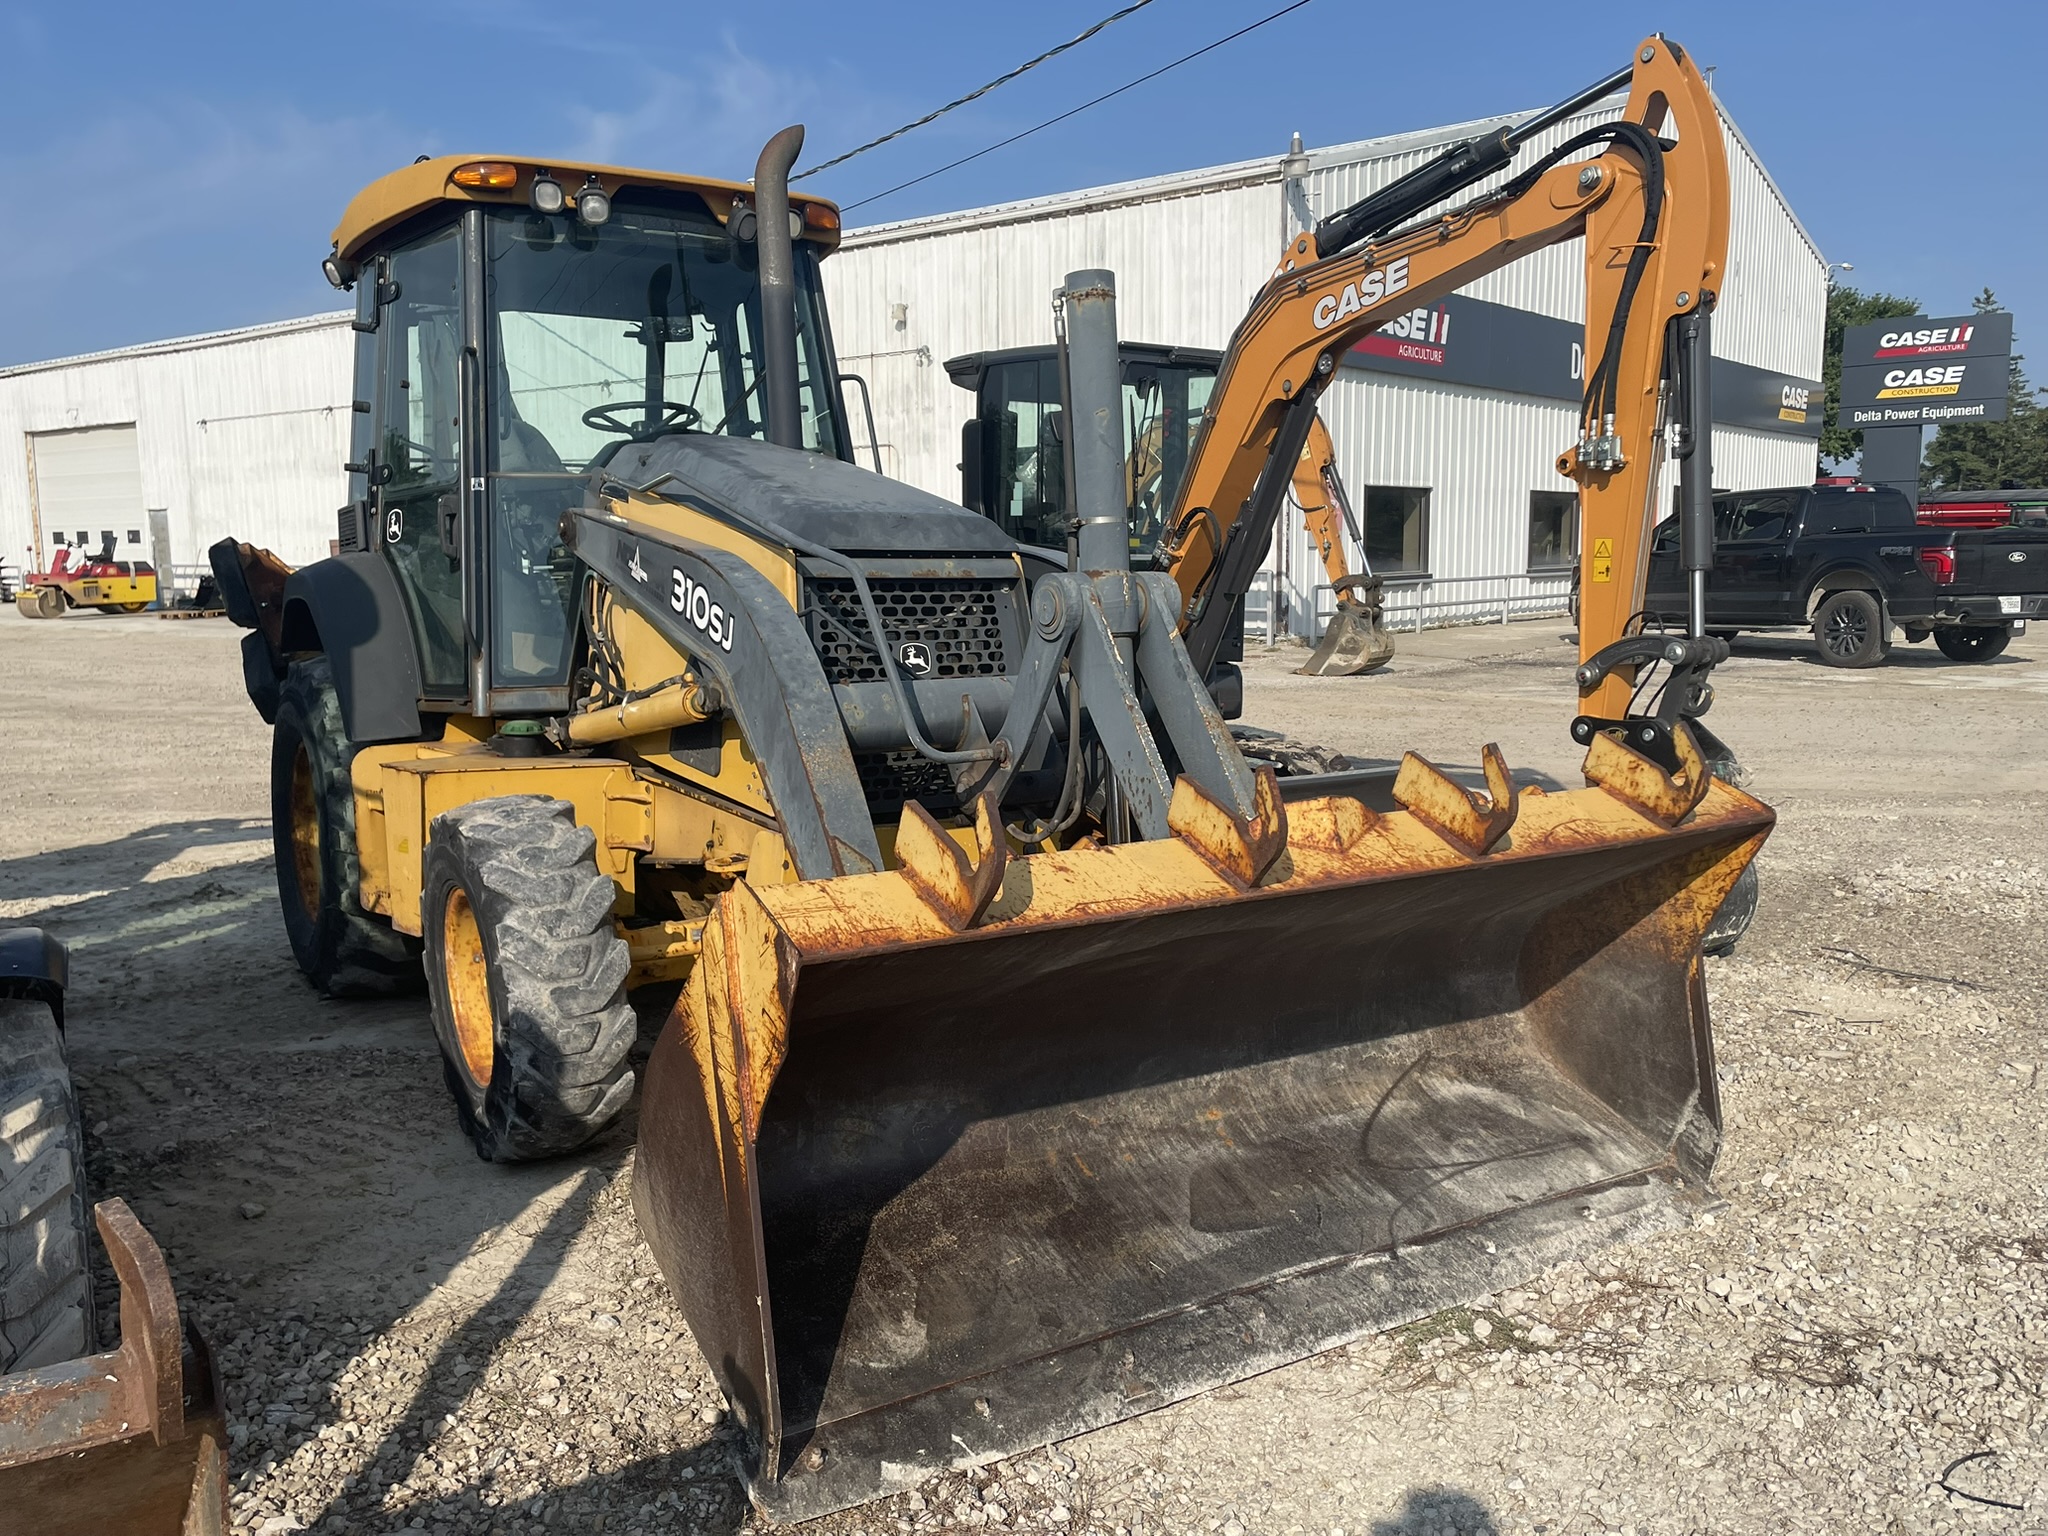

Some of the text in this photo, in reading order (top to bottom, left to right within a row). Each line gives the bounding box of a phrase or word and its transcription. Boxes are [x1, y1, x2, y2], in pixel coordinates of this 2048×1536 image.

[1313, 255, 1410, 330] CASE
[1880, 328, 1949, 348] CASE
[1918, 343, 1965, 353] AGRICULTURE
[1398, 344, 1443, 363] AGRICULTURE
[1884, 365, 1966, 388] CASE
[1781, 384, 1809, 410] CASE
[1891, 386, 1957, 396] CONSTRUCTION
[1854, 404, 1985, 422] Delta Power Equipment
[670, 567, 736, 653] 310SJ
